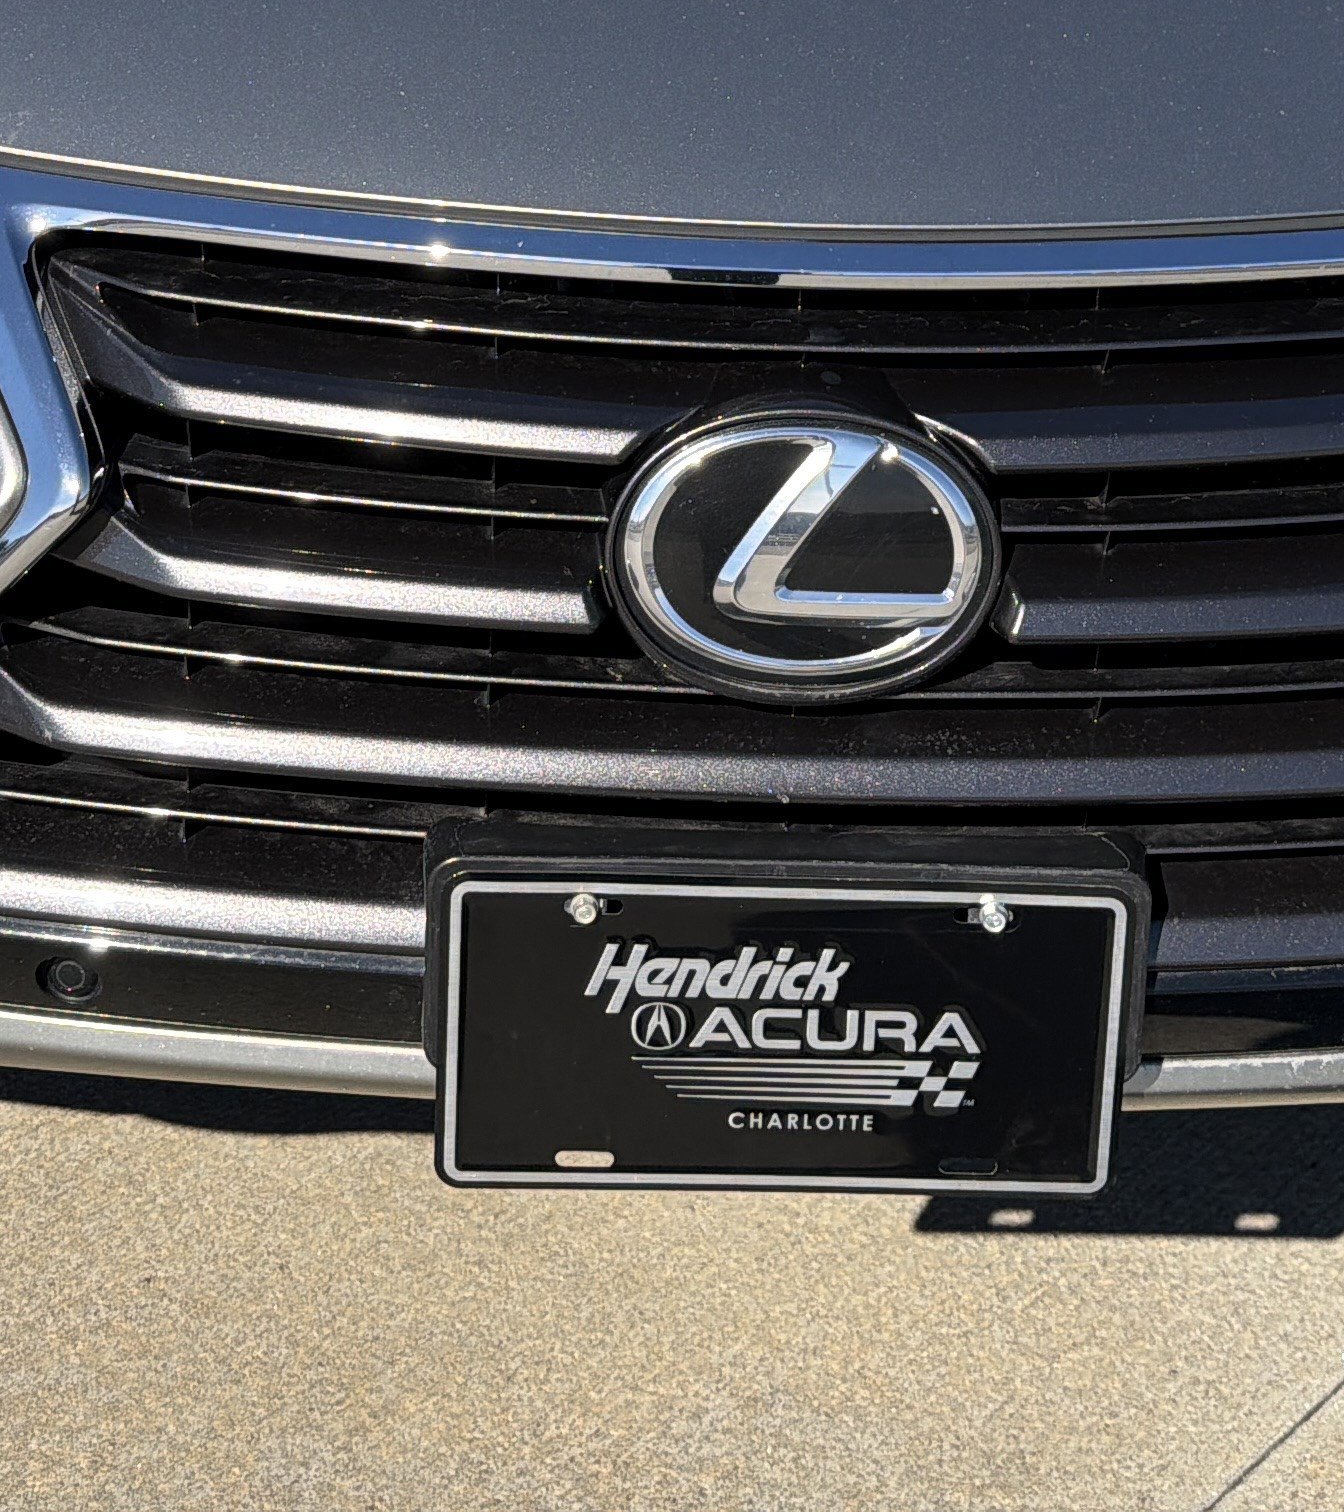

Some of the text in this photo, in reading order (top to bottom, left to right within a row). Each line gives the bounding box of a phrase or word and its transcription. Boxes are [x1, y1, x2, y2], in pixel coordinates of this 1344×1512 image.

[583, 943, 850, 1014] Hendrick
[688, 1006, 981, 1054] ACURA
[727, 1111, 873, 1132] CHARLOTTE
